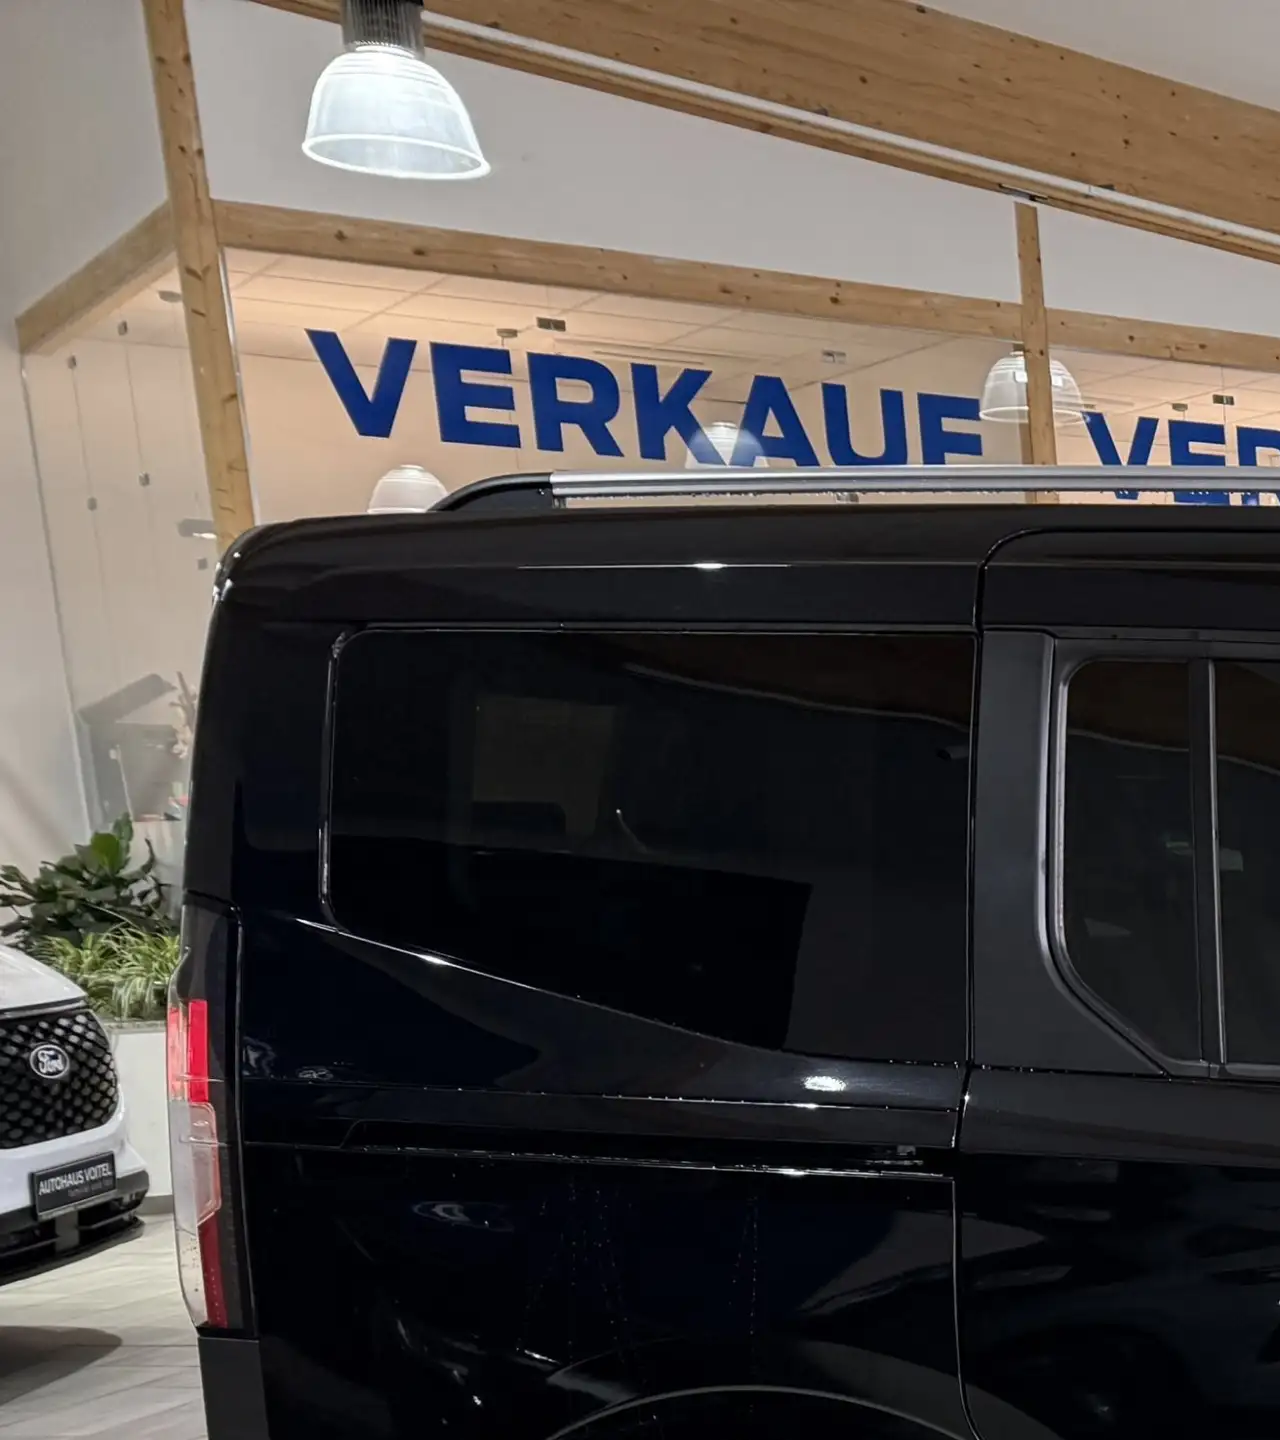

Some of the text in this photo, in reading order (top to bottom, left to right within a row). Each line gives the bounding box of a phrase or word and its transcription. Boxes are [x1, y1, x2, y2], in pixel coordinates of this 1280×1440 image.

[305, 328, 983, 467] VERKAUF
[38, 1170, 84, 1196] AUTOHAUS
[84, 1162, 113, 1181] VOITEL
